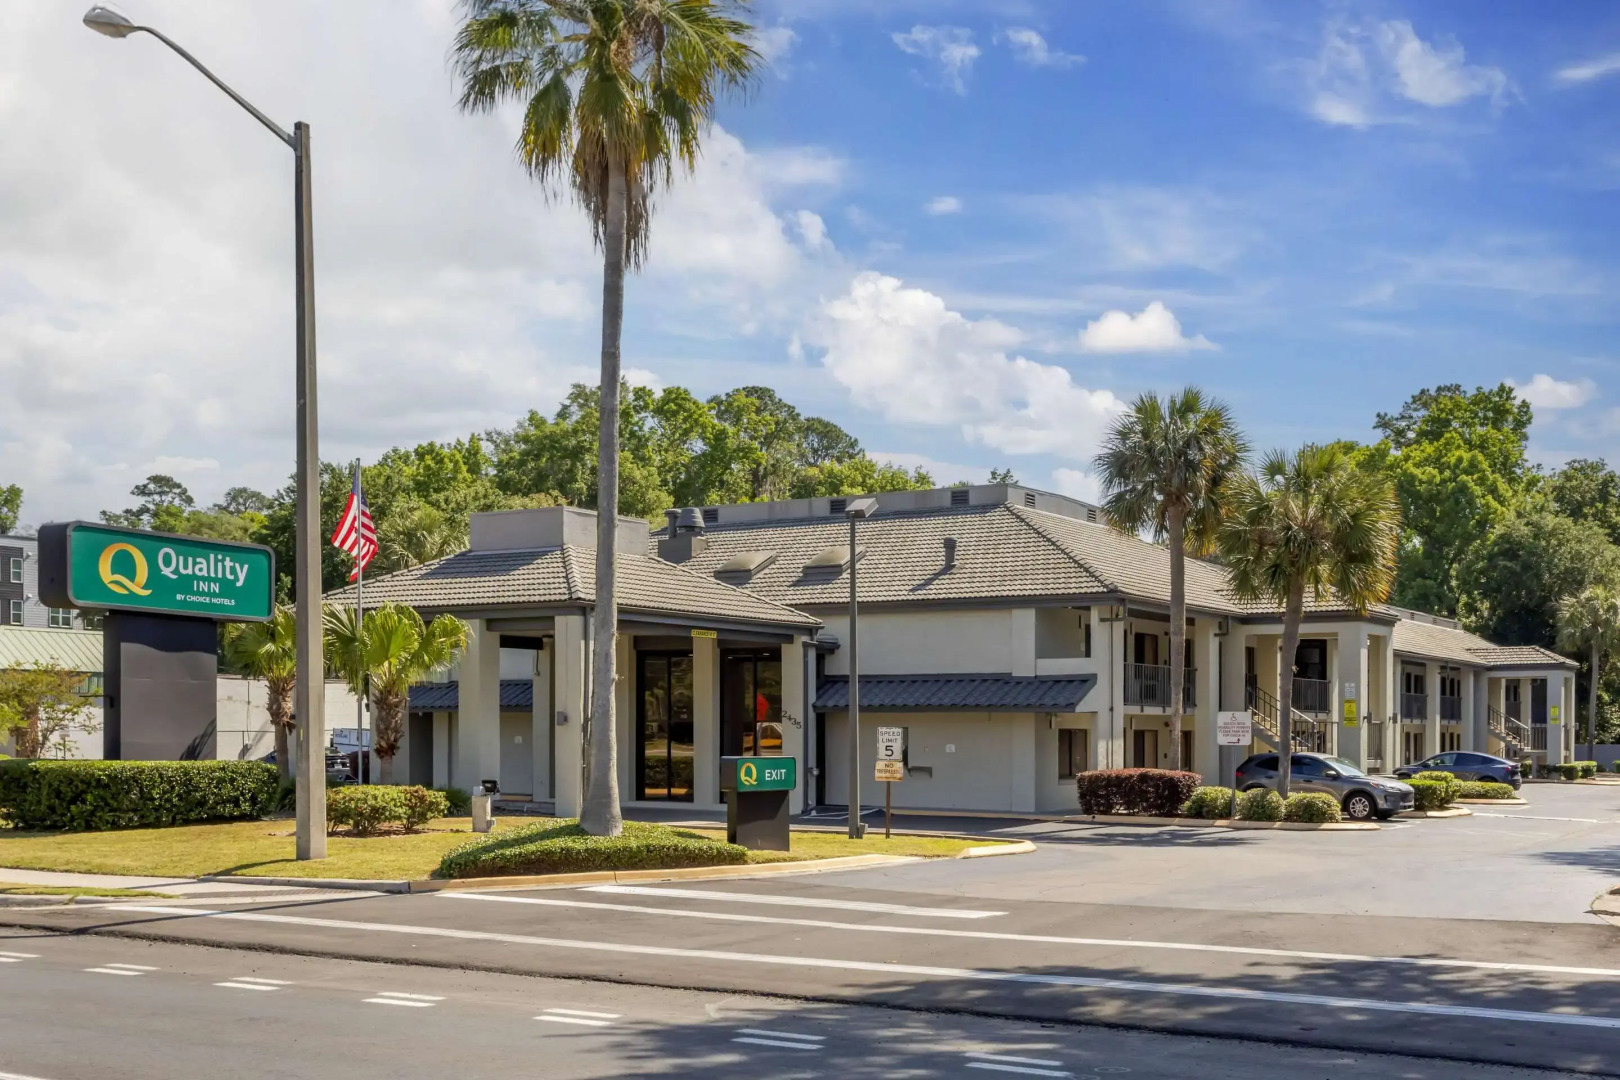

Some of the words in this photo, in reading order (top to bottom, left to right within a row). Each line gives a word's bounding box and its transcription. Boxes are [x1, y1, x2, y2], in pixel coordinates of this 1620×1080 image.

[98, 543, 152, 596] Q
[157, 547, 249, 587] Quality
[193, 580, 220, 594] INN
[176, 593, 185, 601] BY
[186, 595, 210, 604] CHOICE
[211, 597, 236, 606] HOTELS
[782, 710, 802, 730] 2435
[884, 745, 894, 757] 5
[740, 762, 758, 785] Q
[765, 769, 787, 781] EXIT
